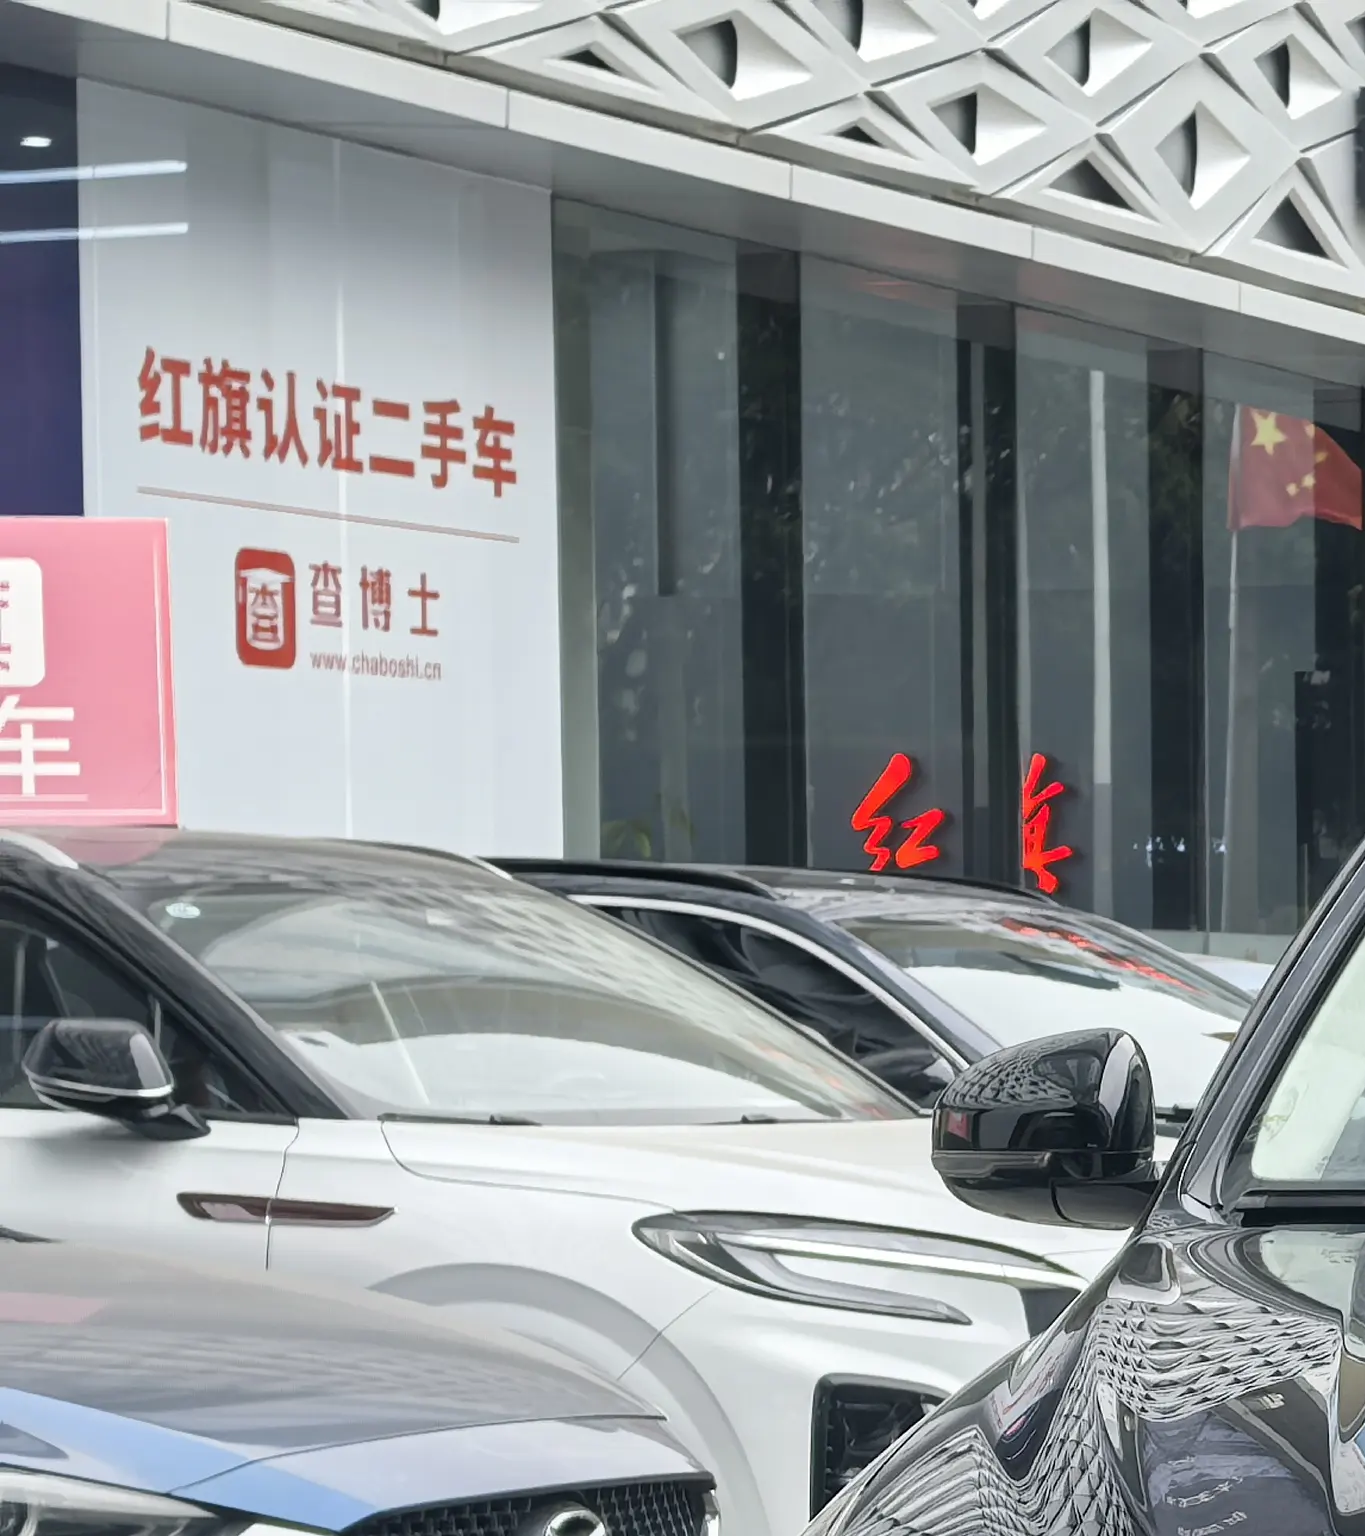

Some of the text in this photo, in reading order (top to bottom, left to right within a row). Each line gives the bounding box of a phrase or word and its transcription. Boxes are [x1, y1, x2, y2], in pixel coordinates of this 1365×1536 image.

[137, 346, 518, 499] 红旗认证二手车
[308, 560, 440, 637] 查博士
[309, 650, 442, 681] www.chaboshi.cn
